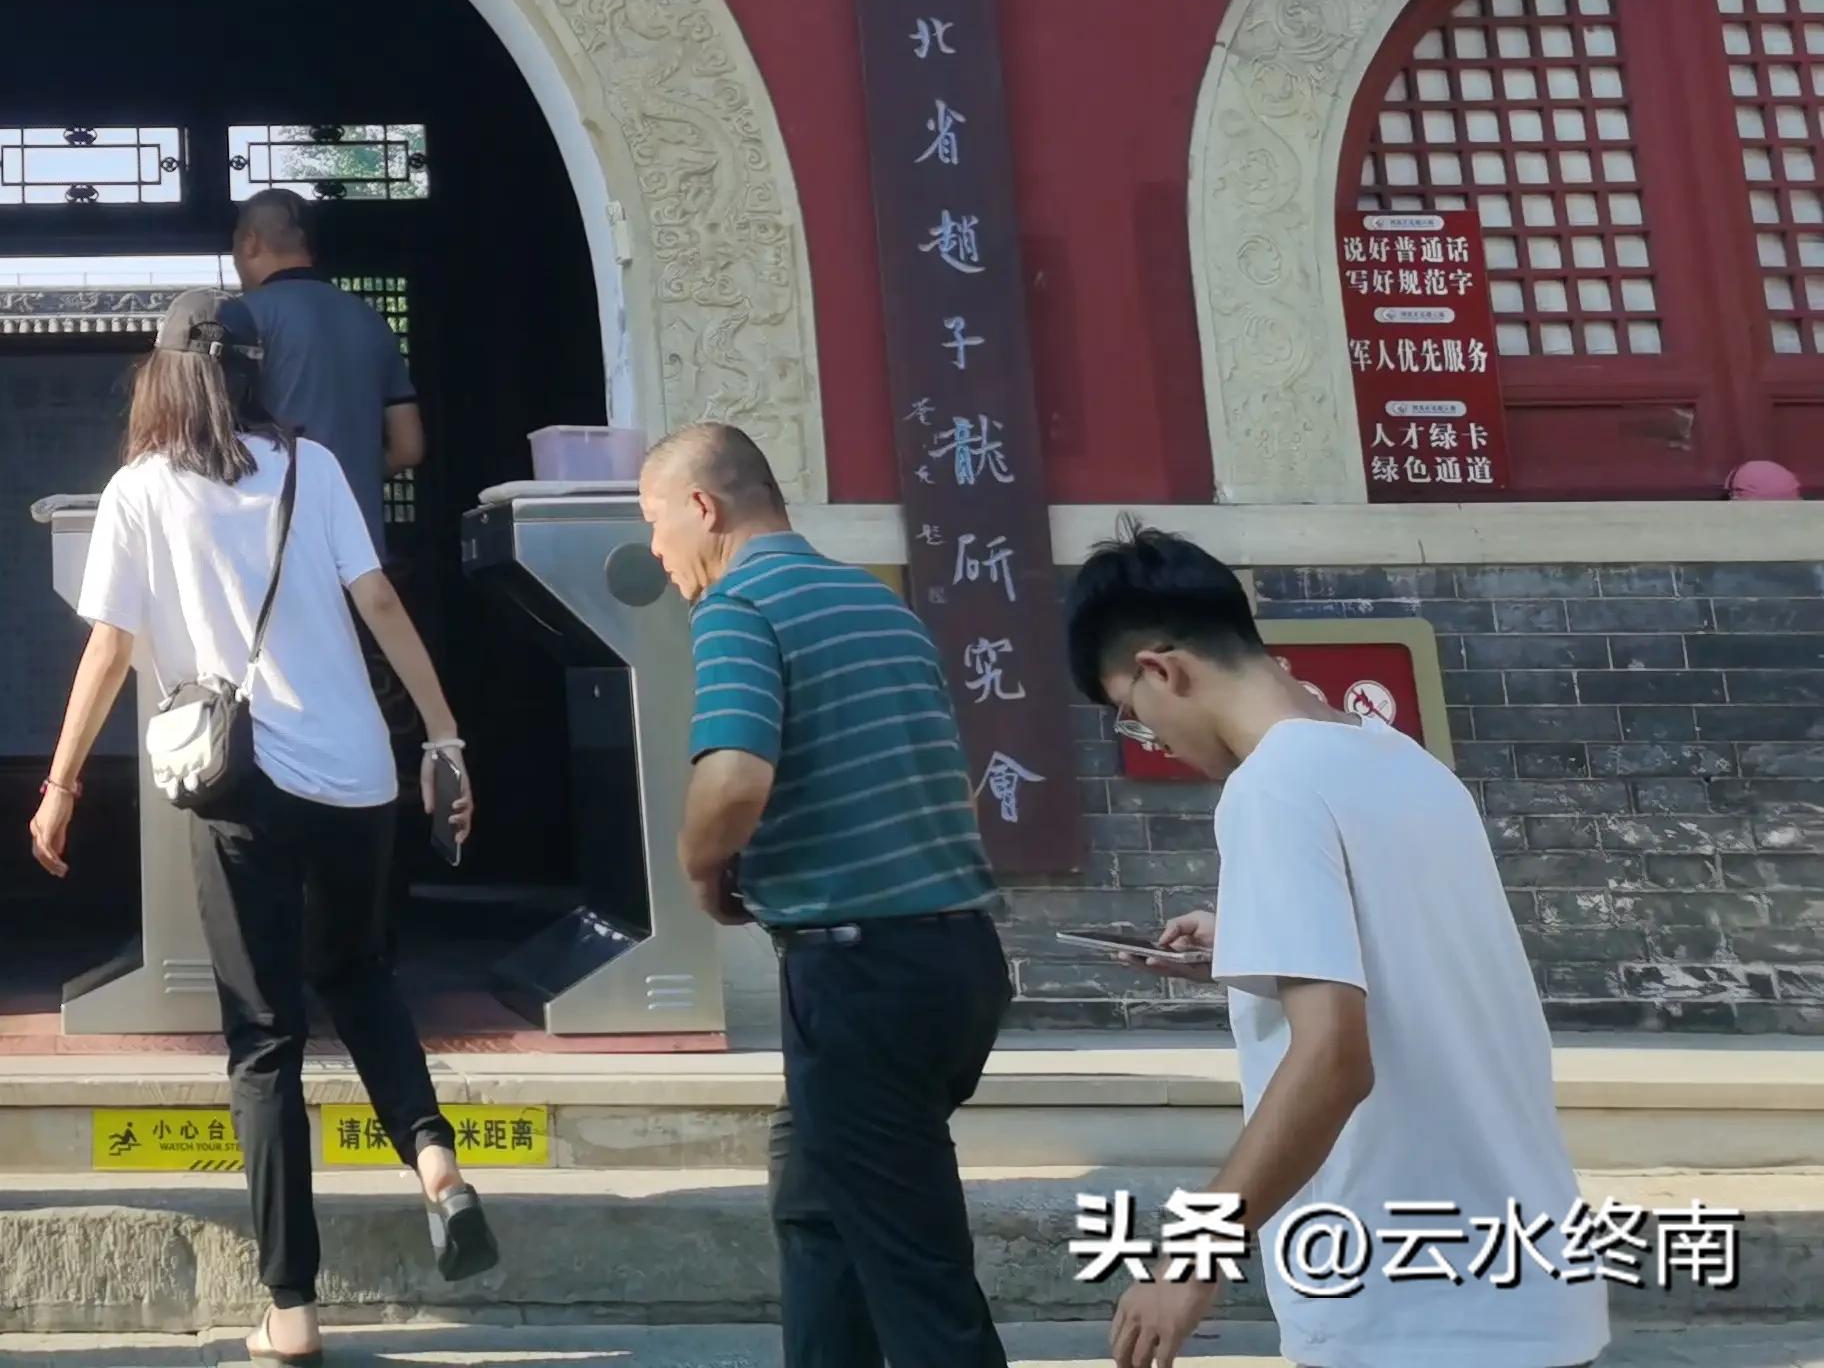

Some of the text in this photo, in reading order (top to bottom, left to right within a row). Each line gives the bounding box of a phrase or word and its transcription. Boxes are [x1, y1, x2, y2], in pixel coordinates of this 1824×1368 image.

[1343, 236, 1469, 263] 说好普通话
[1345, 269, 1473, 295] 写好规范字
[1349, 338, 1488, 373] 军人优先服务
[1371, 422, 1488, 450] 人才绿卡
[1371, 456, 1493, 483] 绿色通道
[153, 1120, 238, 1140] 小心台
[160, 1143, 193, 1151] WATCH
[196, 1143, 222, 1151] YOUR
